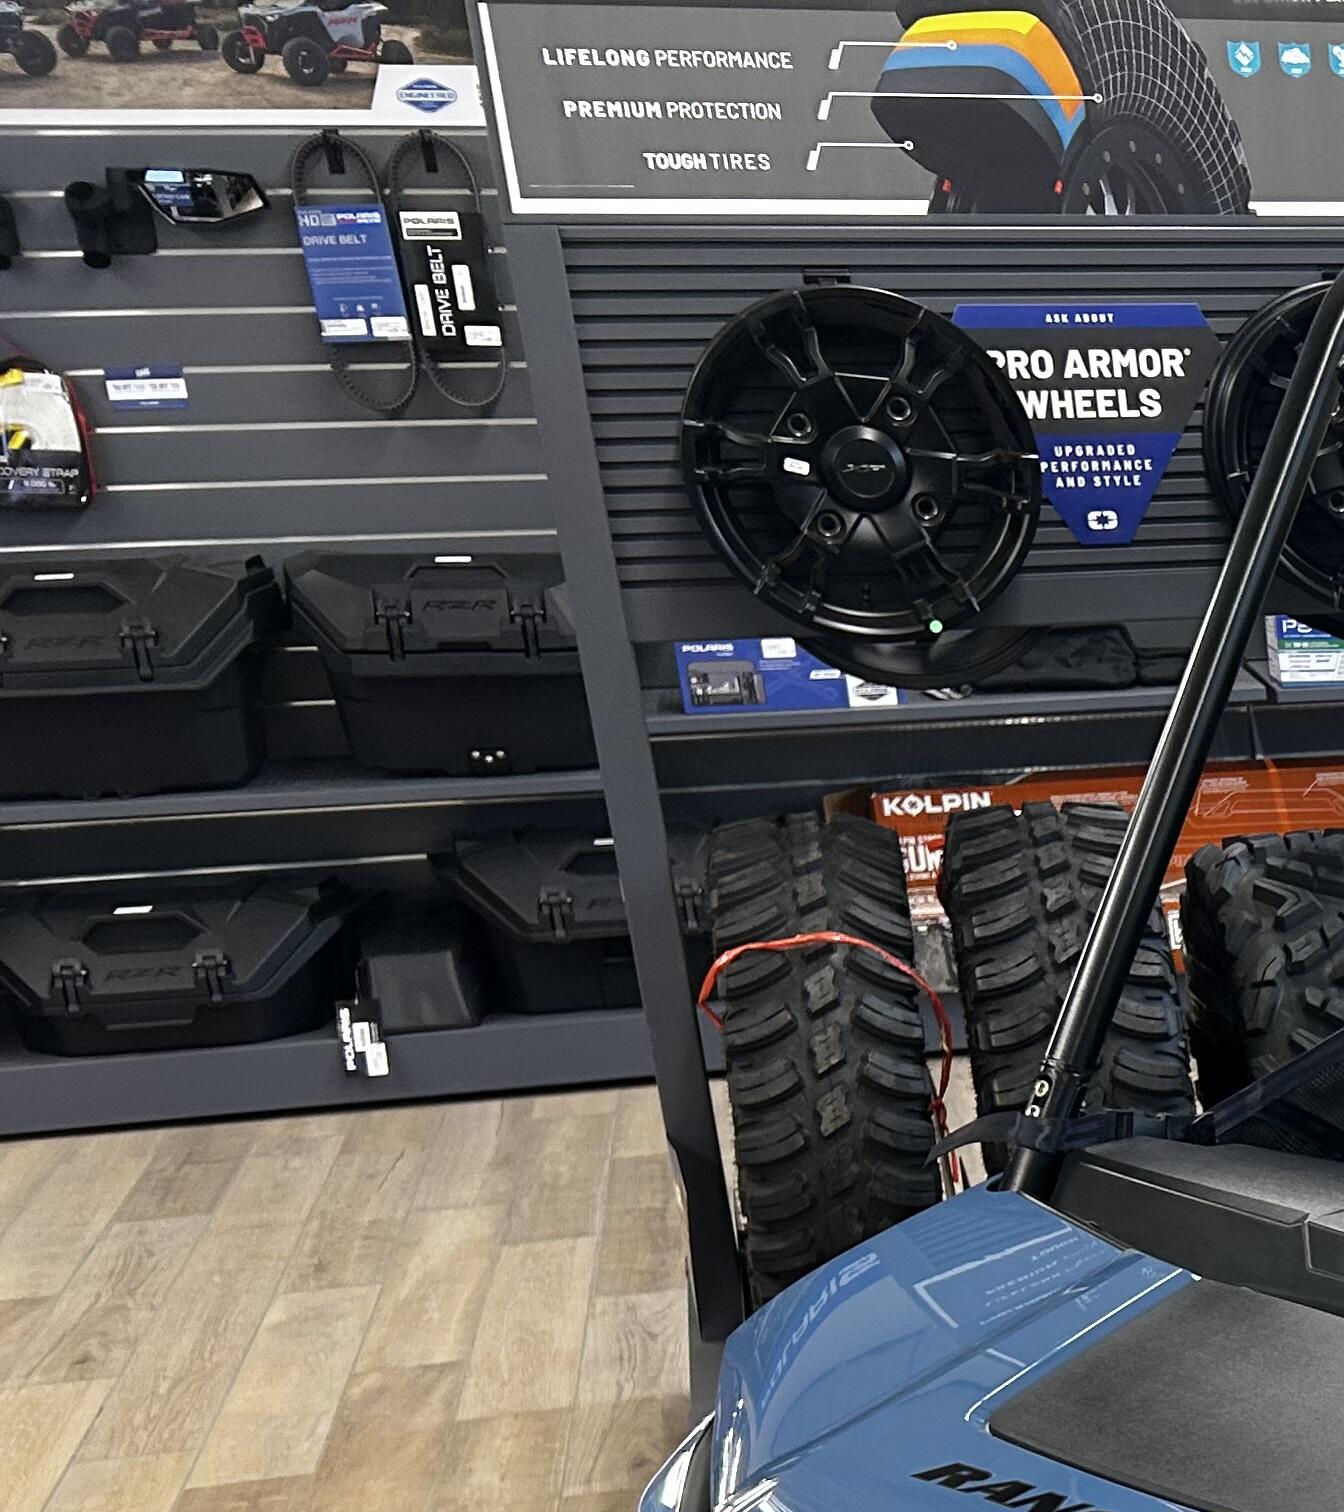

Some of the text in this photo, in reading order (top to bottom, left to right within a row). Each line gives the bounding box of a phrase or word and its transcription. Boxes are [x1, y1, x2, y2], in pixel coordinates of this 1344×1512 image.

[541, 47, 793, 69] LIFELONG PERFORMANCE
[562, 100, 782, 120] PREMIUM PROTECTION
[642, 152, 771, 171] TOUGH TIRES
[303, 234, 367, 246] DRIVE BELT
[427, 245, 447, 284] BELT
[435, 288, 456, 337] DRIVE
[1045, 313, 1114, 323] ASK ABOUT
[1016, 388, 1162, 420] WHEELS
[1054, 444, 1136, 457] UPGRADED
[1040, 459, 1153, 473] PERFORMANCE
[1056, 475, 1142, 488] AND STYLE
[883, 791, 991, 817] KOLPIN
